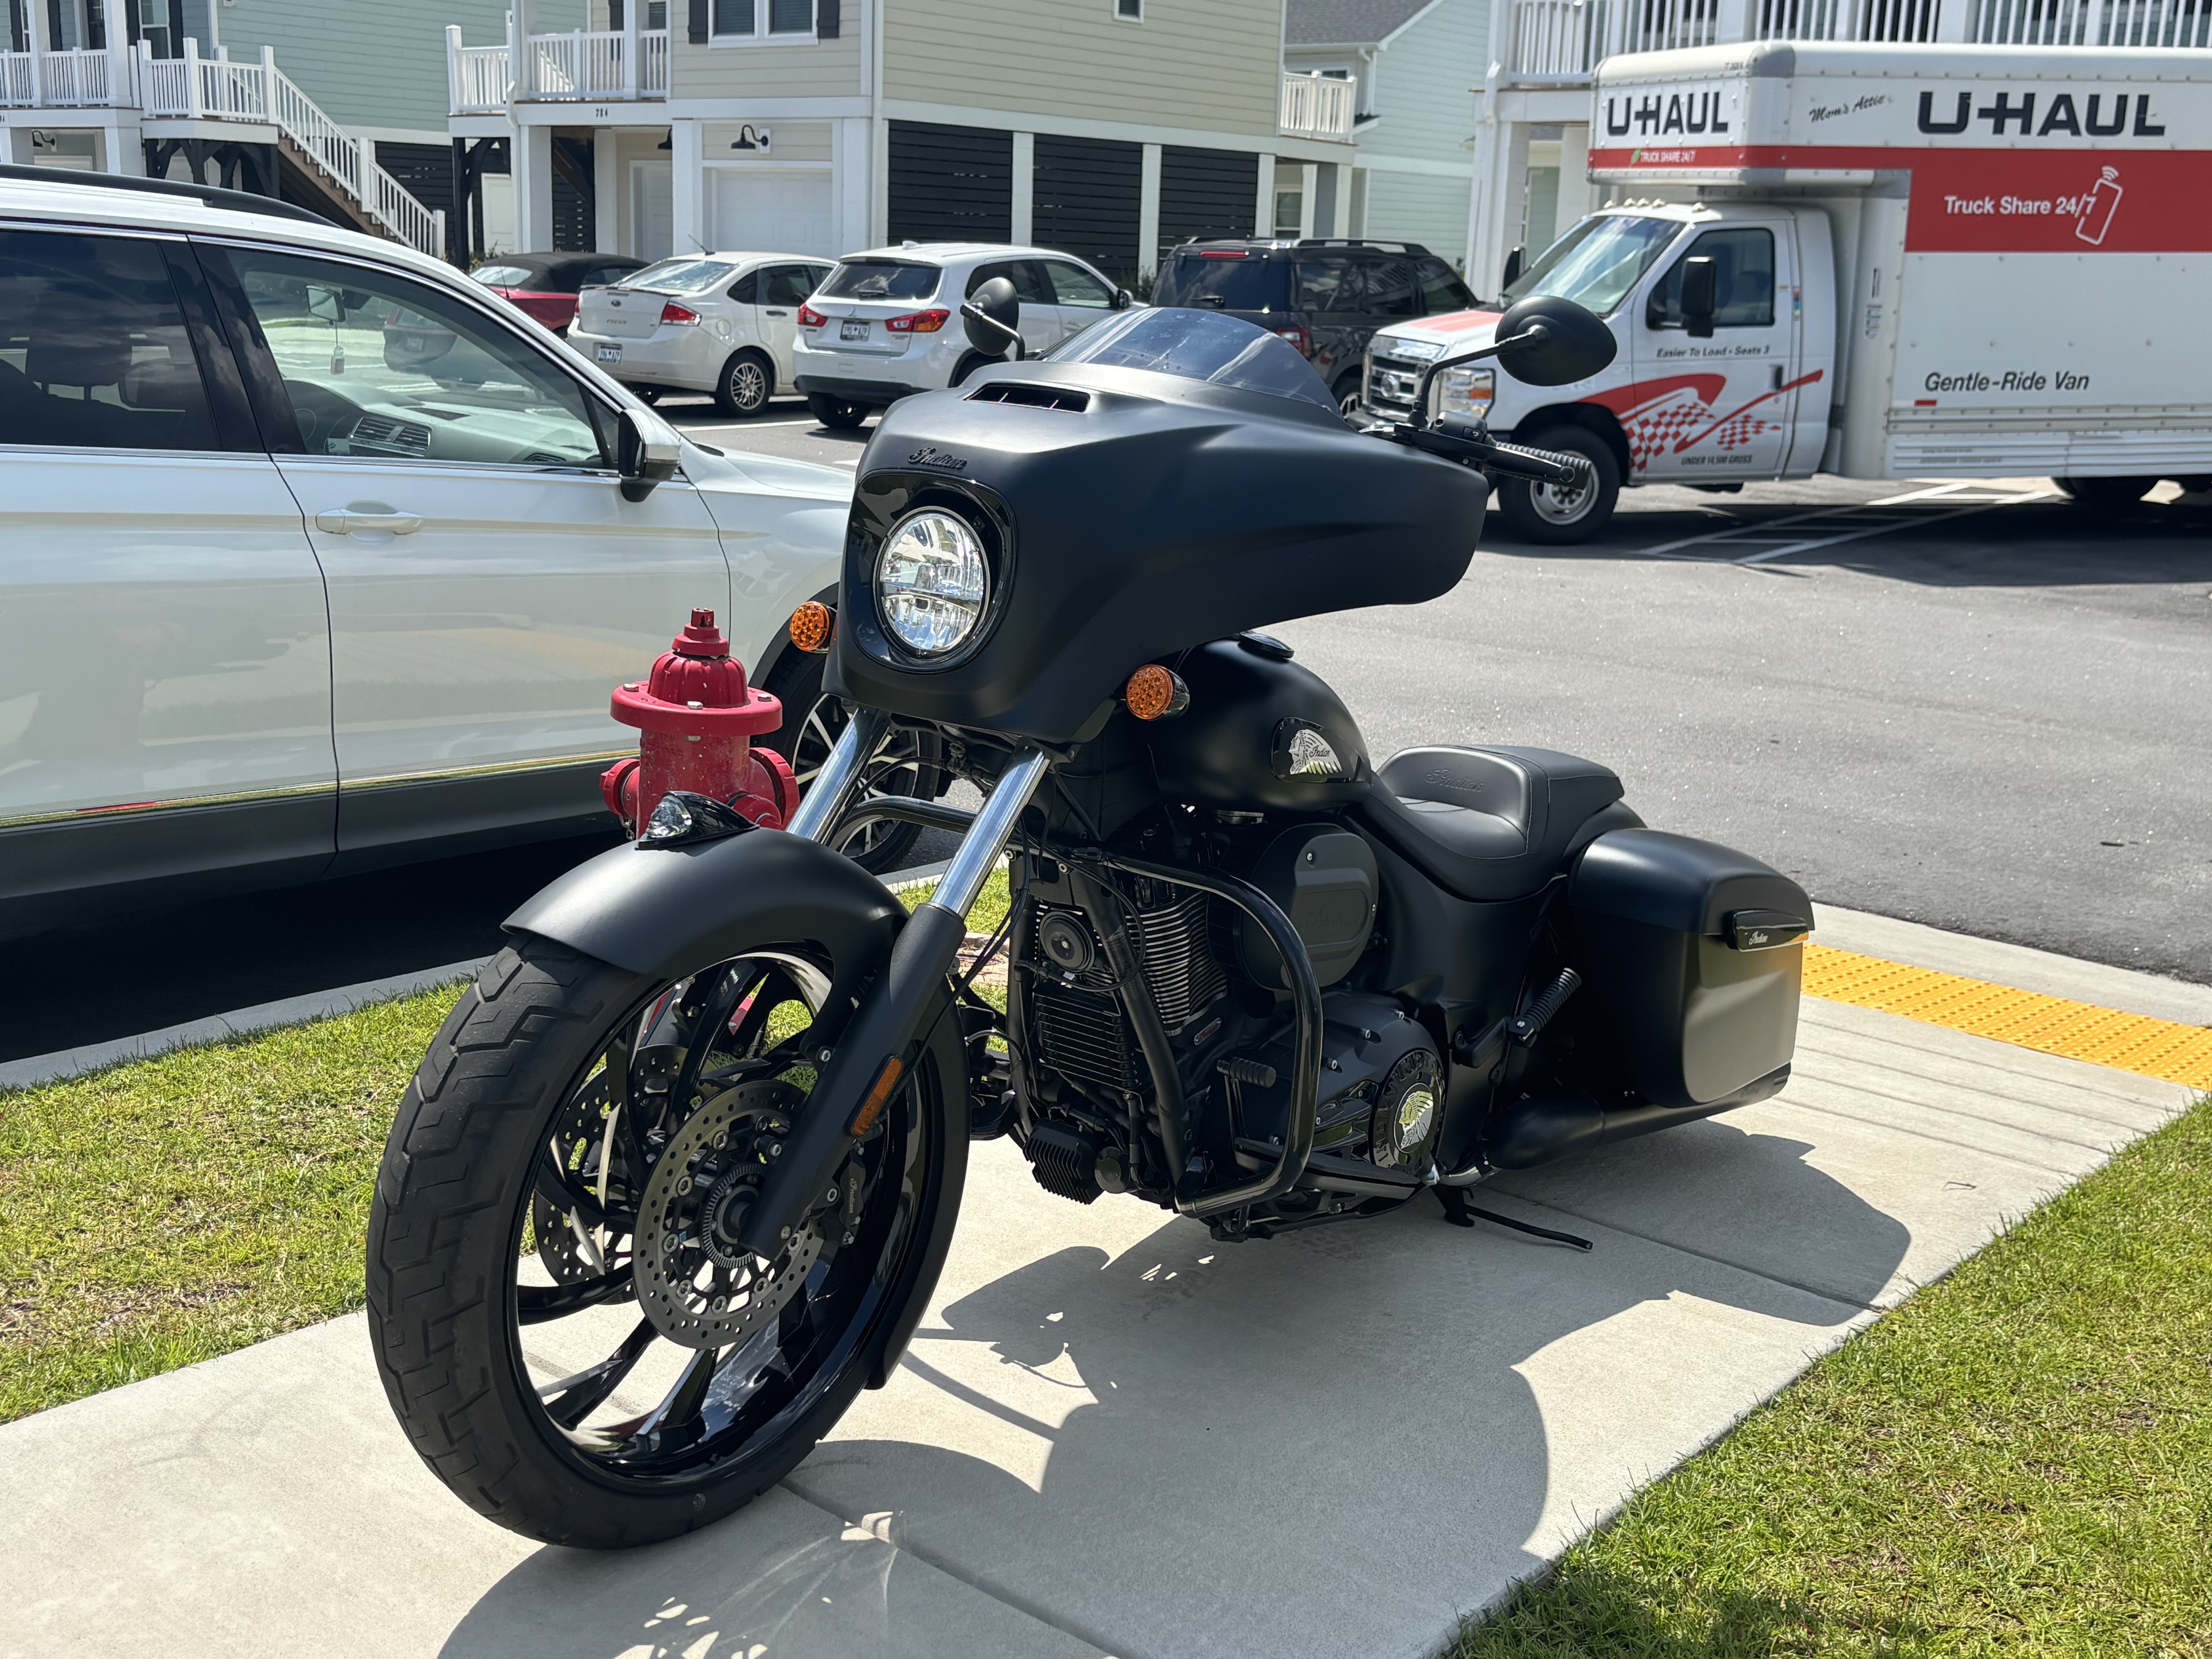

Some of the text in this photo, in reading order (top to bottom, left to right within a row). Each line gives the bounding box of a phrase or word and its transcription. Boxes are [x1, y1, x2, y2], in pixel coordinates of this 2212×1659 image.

[1607, 91, 1729, 136] U-HAUL
[1918, 91, 2166, 137] U-HAUL
[1640, 149, 1697, 163] TRUCK SHARE 24/7
[1944, 192, 2097, 218] Truck Share 24/7
[1656, 344, 1771, 358] Easier To Load Seats 3
[1924, 371, 2090, 392] Gentle-Ride Van
[908, 447, 967, 470] Indian
